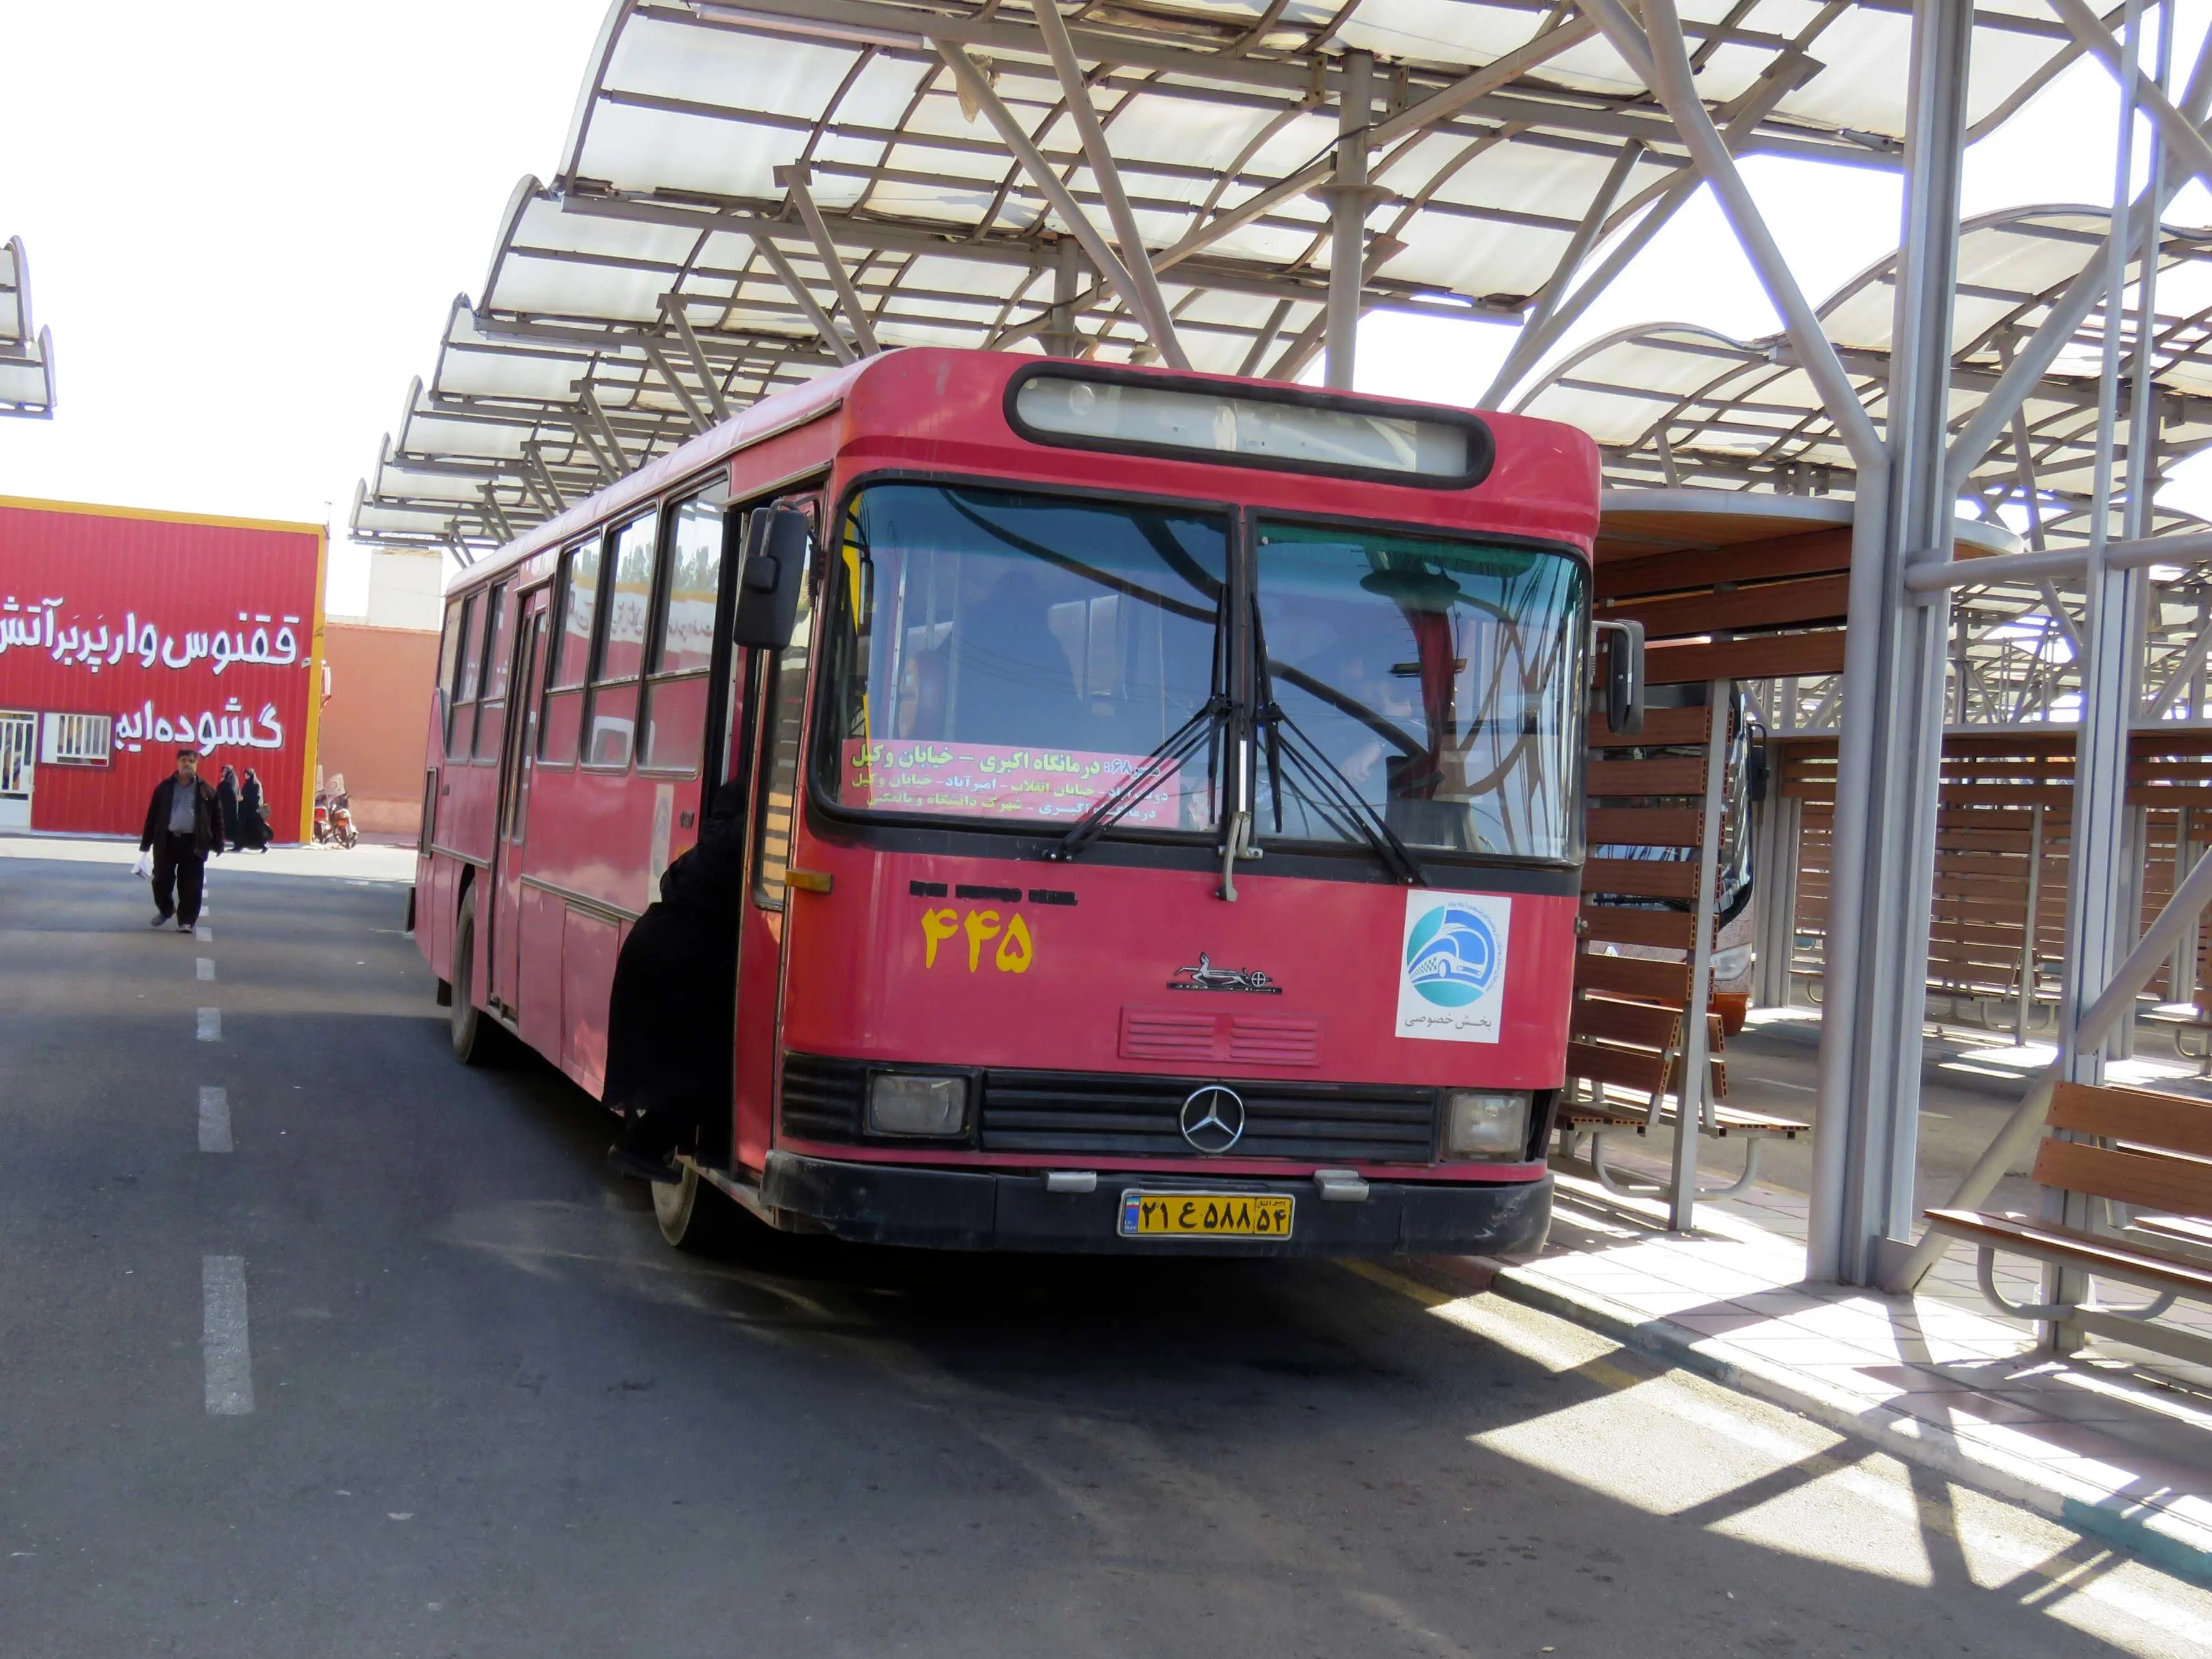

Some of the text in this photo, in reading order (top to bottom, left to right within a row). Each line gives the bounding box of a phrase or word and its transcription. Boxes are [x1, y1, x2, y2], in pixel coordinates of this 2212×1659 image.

[107, 612, 159, 669] وار
[162, 612, 300, 676] ققنوس
[851, 743, 894, 768] وکیل
[898, 744, 954, 769] خیابان
[978, 751, 1030, 774] اکبری
[1032, 753, 1102, 779] درمانگاه
[888, 773, 933, 789] خیابان
[1010, 780, 1050, 794] انقلاب
[1053, 782, 1096, 797] خیابان
[920, 908, 1033, 974] ۴۴۵
[1405, 1014, 1492, 1031] بخش خصوصی
